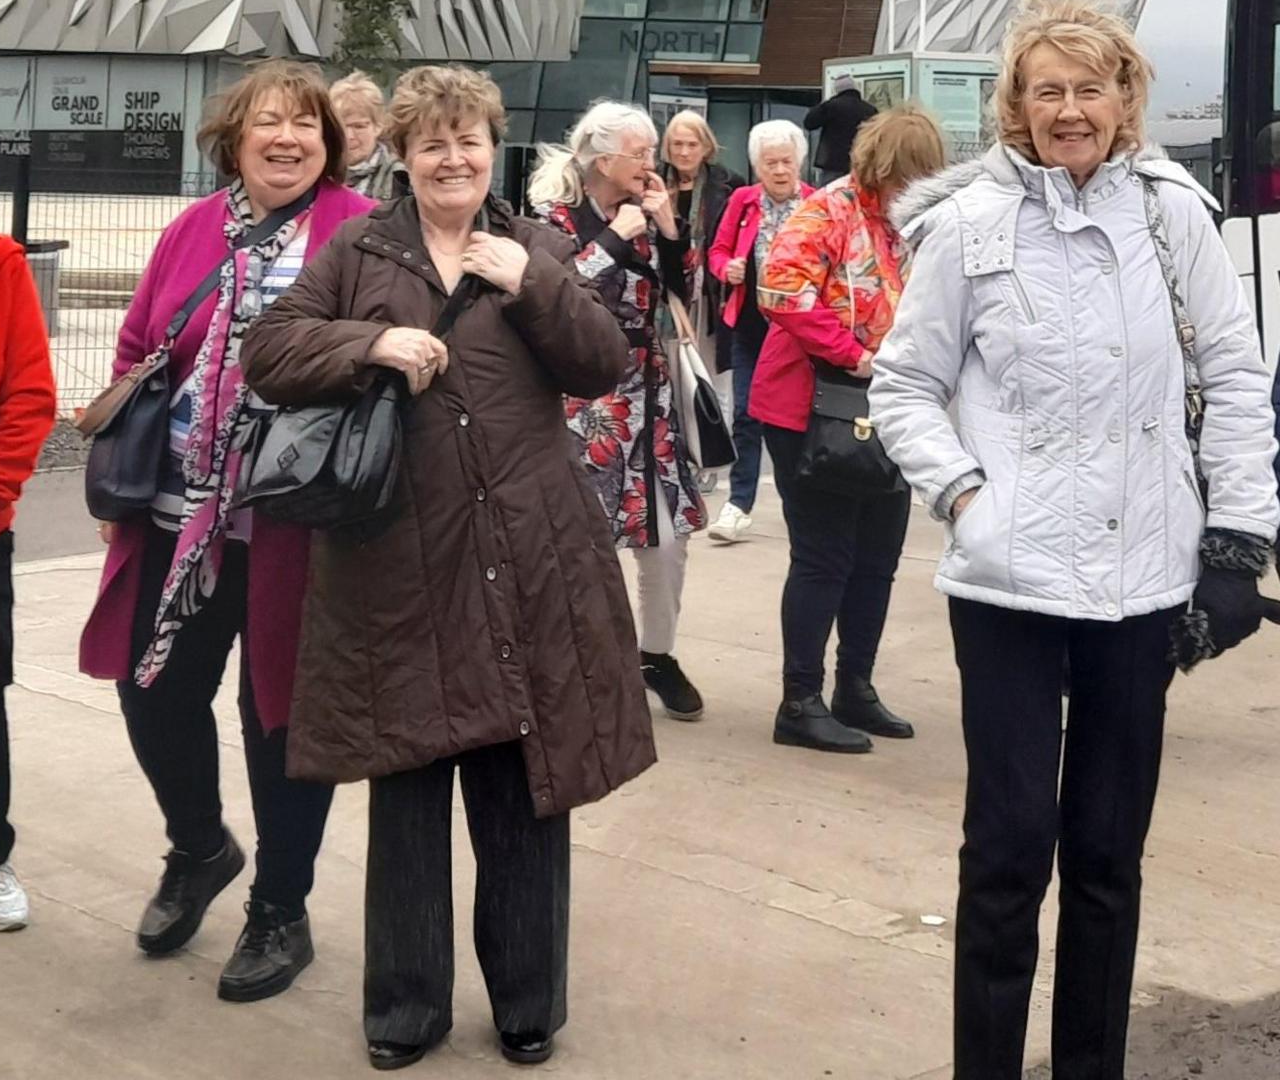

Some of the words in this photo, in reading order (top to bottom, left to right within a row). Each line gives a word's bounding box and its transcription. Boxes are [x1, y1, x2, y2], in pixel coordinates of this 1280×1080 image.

[619, 30, 721, 54] NORTH
[51, 96, 99, 111] GRAND
[124, 91, 160, 110] SHIP
[70, 112, 103, 125] SCALE
[124, 112, 182, 131] DESIGN
[123, 133, 166, 146] THOMAS
[0, 143, 31, 155] PLANS
[122, 146, 171, 160] ANDREWS
